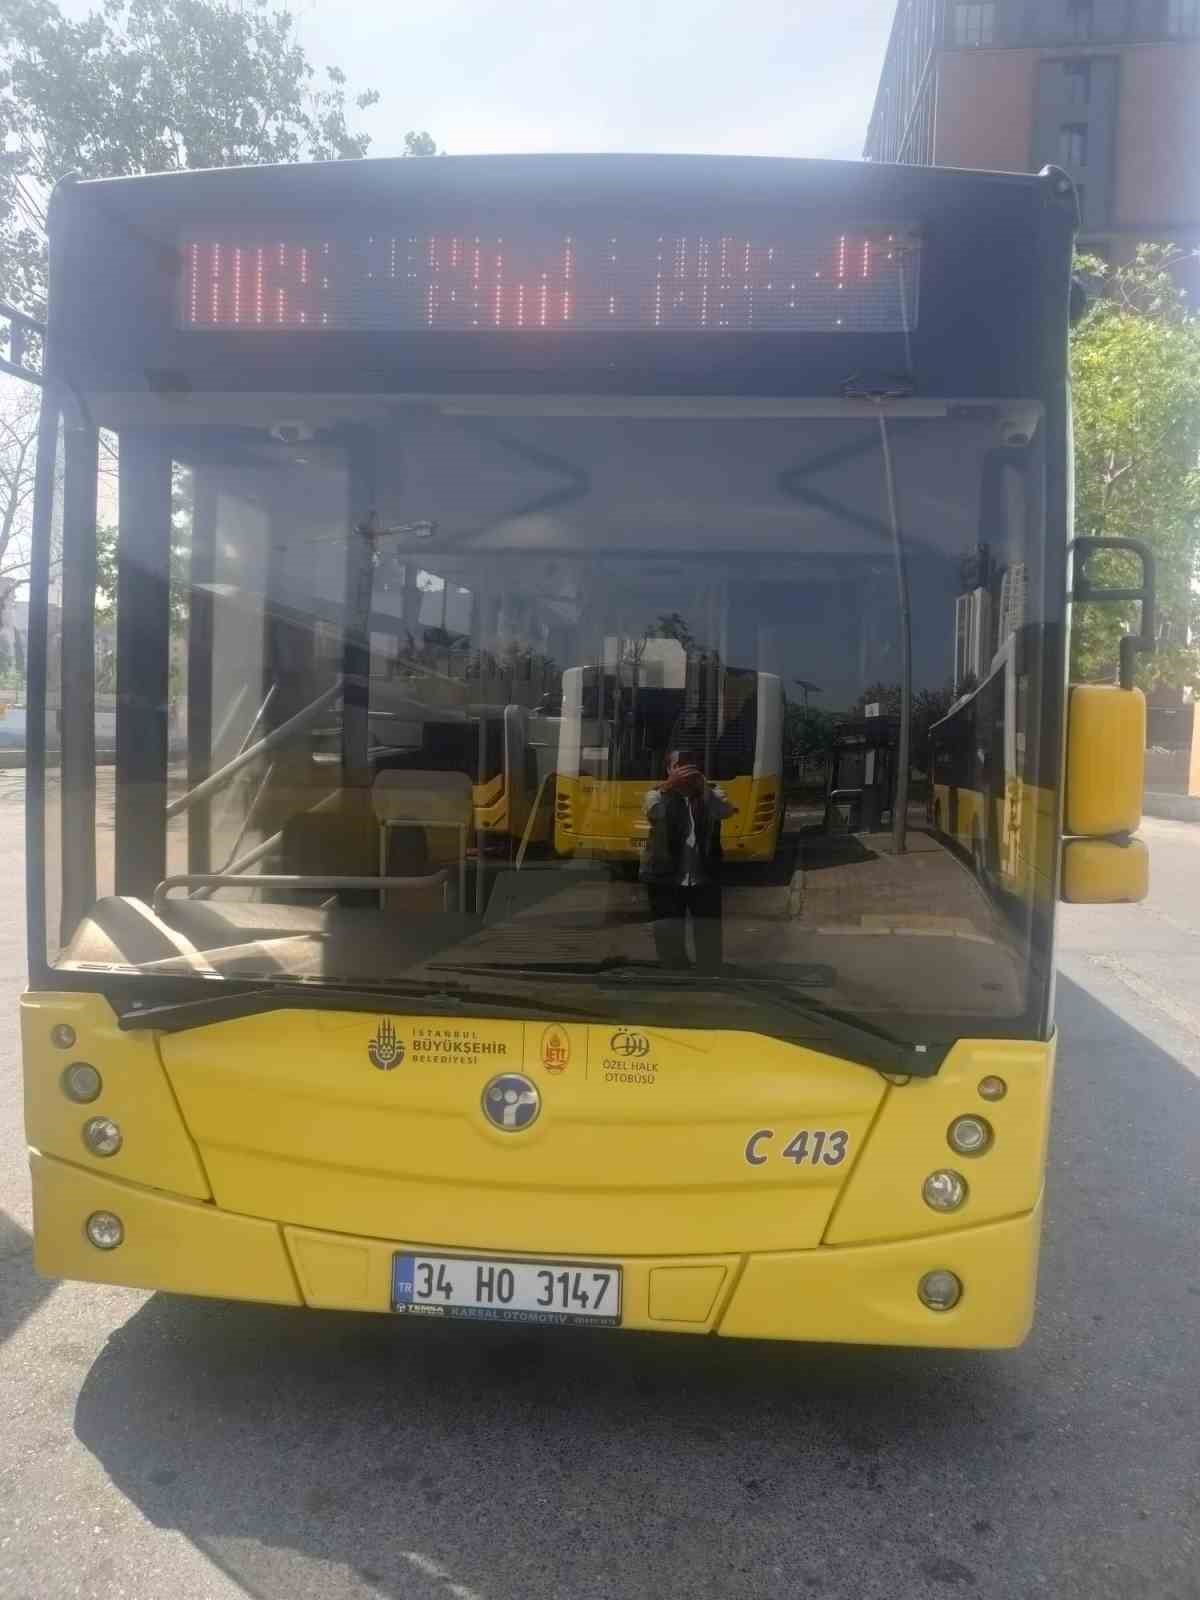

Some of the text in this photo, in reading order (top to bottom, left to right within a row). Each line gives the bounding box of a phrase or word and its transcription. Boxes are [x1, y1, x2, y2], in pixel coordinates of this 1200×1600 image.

[412, 1038, 507, 1055] BÜYÜKŞEHİR
[631, 1060, 659, 1073] HALK
[745, 1129, 849, 1167] C 413
[399, 1282, 413, 1294] TR
[416, 1262, 454, 1300] 34
[536, 1270, 611, 1310] 3147
